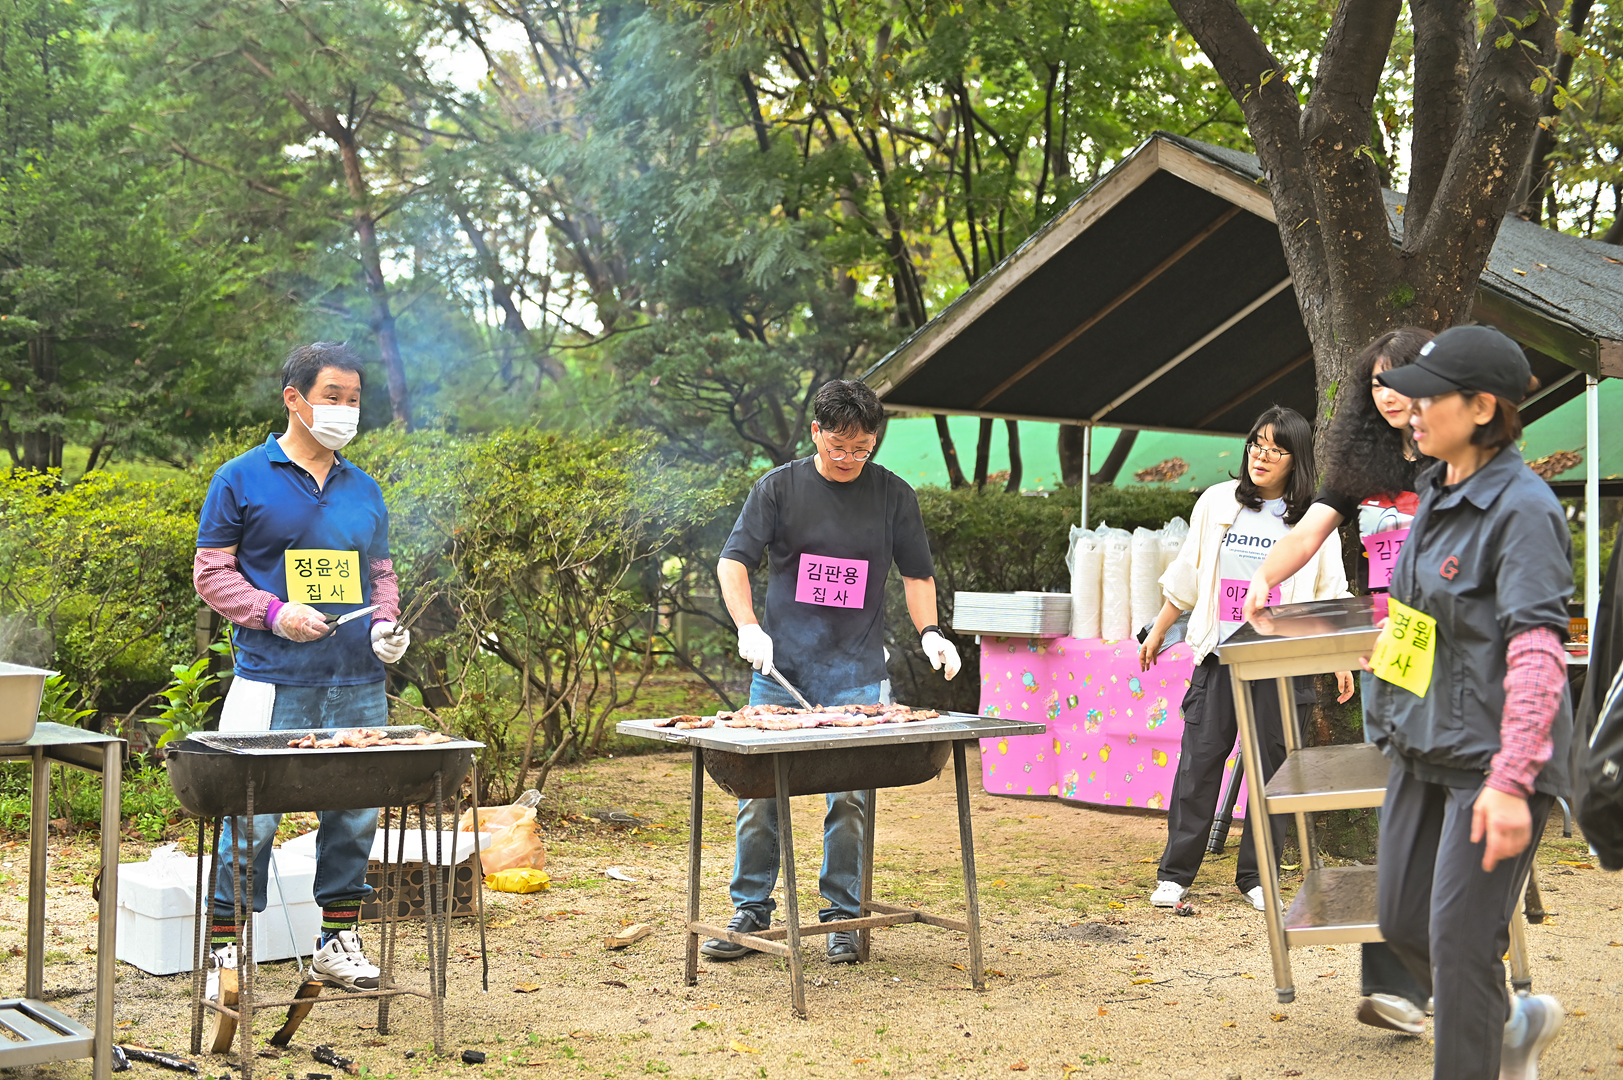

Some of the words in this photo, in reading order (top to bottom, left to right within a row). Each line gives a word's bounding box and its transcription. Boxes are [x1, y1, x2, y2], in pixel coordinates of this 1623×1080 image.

[1221, 532, 1277, 549] pano
[294, 558, 350, 578] 정윤성
[807, 562, 859, 585] 김판용
[1440, 556, 1459, 581] G
[1393, 609, 1433, 651] 명월
